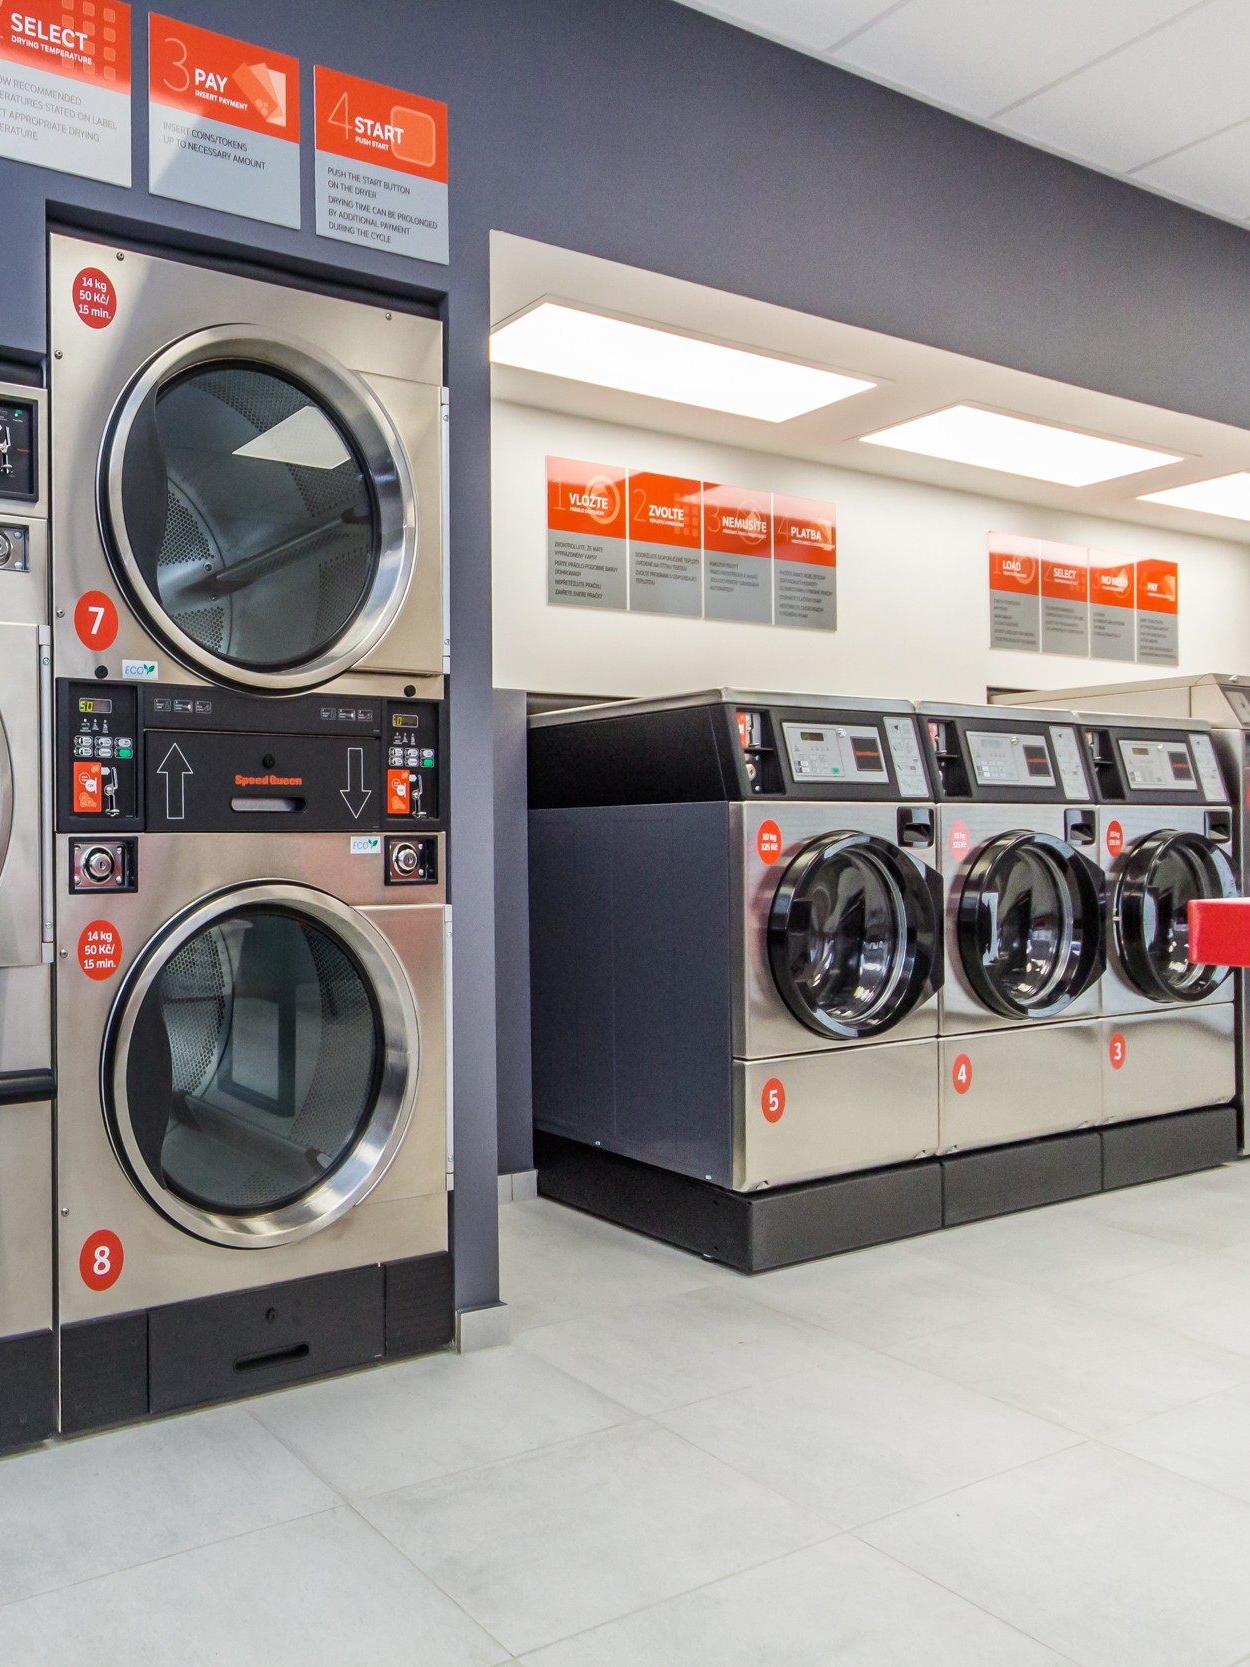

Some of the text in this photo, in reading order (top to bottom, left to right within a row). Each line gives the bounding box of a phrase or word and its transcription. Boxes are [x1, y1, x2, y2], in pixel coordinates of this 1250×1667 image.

[11, 13, 88, 51] SELECT
[11, 36, 92, 65] DRYING TEMPERATURE
[163, 37, 189, 92] 3
[194, 68, 228, 93] PAY
[14, 79, 81, 105] RECOMMENDED
[195, 90, 248, 111] INSERT PAYMENT
[45, 103, 75, 118] STATED
[78, 112, 90, 122] ON
[92, 116, 117, 129] LABEL
[327, 92, 352, 140] 4
[9, 111, 66, 133] APPROPRIATE
[69, 127, 100, 142] DRYING
[355, 117, 404, 144] START
[163, 122, 247, 151] INSERT COINS/TOKENS
[355, 136, 389, 151] PUSH START
[164, 135, 265, 170] UP TO NECESSARY AMOUNT
[328, 167, 410, 195] PUSH THE START BUTTON
[328, 181, 377, 199] ON THE DRYER
[328, 196, 437, 230] DRYING TIME CAN BE PROLONGED
[328, 208, 410, 235] BY ADDITIONAL PAYMENT
[328, 222, 391, 243] DURING THE CYCLE
[82, 277, 106, 292] 14 kg
[80, 290, 109, 305] 50 Kč/
[79, 304, 111, 319] 15 min.
[569, 493, 608, 509] VLOŽTE
[633, 488, 646, 522] 2
[649, 505, 684, 520] ZVOLTE
[722, 516, 766, 532] NEMUSÍTE
[791, 527, 821, 540] PLATBA
[1003, 560, 1021, 571] LOAD
[1054, 568, 1076, 579] SELECT
[1102, 576, 1111, 584] NO
[1147, 582, 1158, 591] PAY
[88, 607, 105, 635] 7
[125, 665, 144, 675] ECO
[80, 701, 93, 711] 50
[235, 774, 302, 786] Speed Queen
[352, 840, 369, 850] ECO
[770, 834, 777, 842] kg
[88, 931, 112, 943] 14 kg
[85, 942, 115, 956] 50 Kč/
[83, 958, 117, 969] 15 min.
[1114, 1042, 1122, 1060] 3
[958, 1064, 967, 1084] 4
[769, 1089, 779, 1112] 5
[92, 1246, 110, 1276] 8
